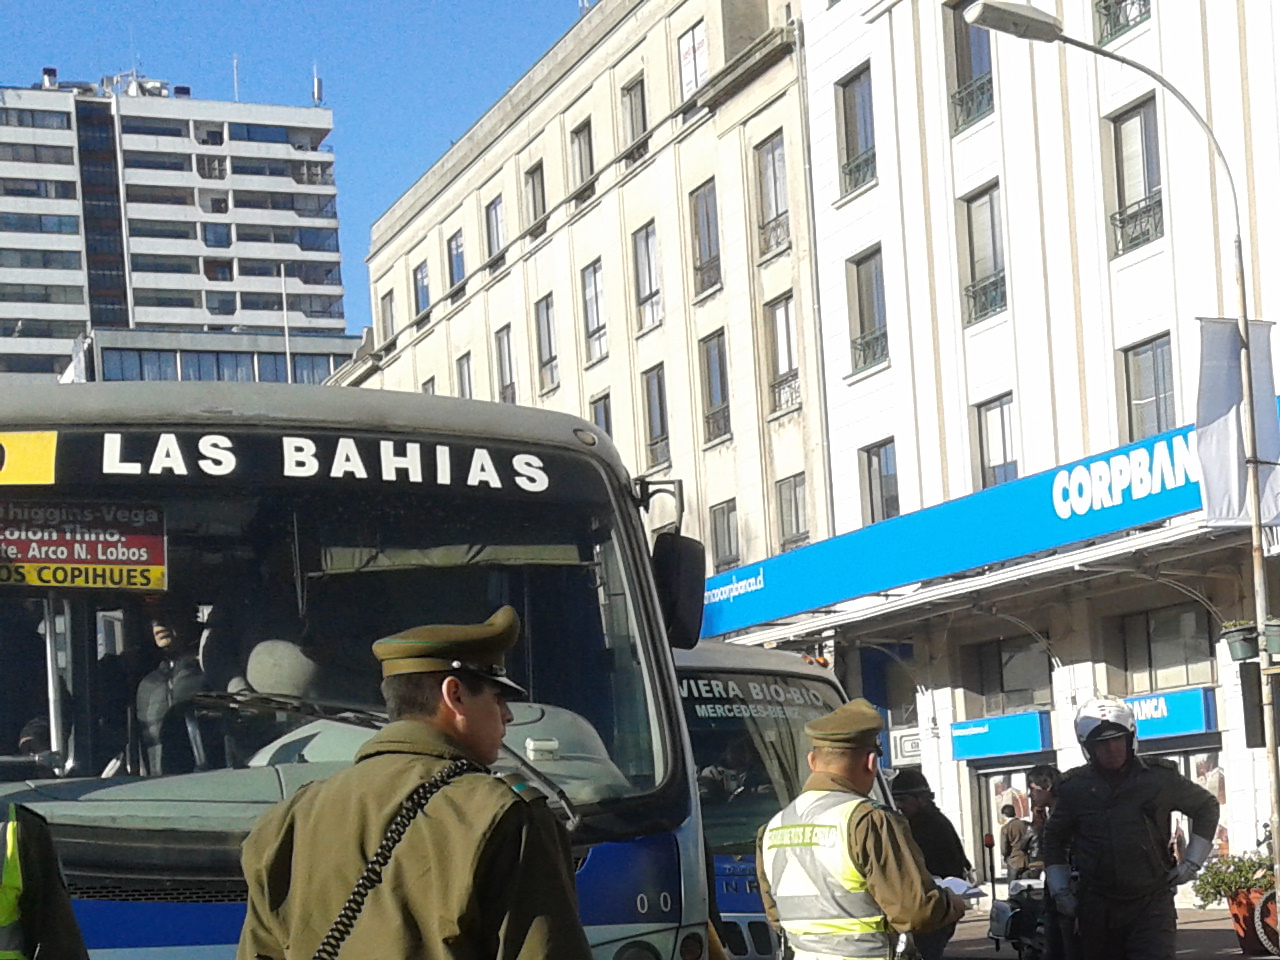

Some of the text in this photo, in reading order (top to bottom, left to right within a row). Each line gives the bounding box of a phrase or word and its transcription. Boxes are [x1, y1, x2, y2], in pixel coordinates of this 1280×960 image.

[102, 433, 549, 492] LAS BAHIAS
[28, 543, 67, 559] Arco
[74, 543, 91, 559] N.
[98, 543, 148, 561] Lobos
[37, 566, 151, 586] COPIHUES
[748, 682, 824, 706] BIO-BIO
